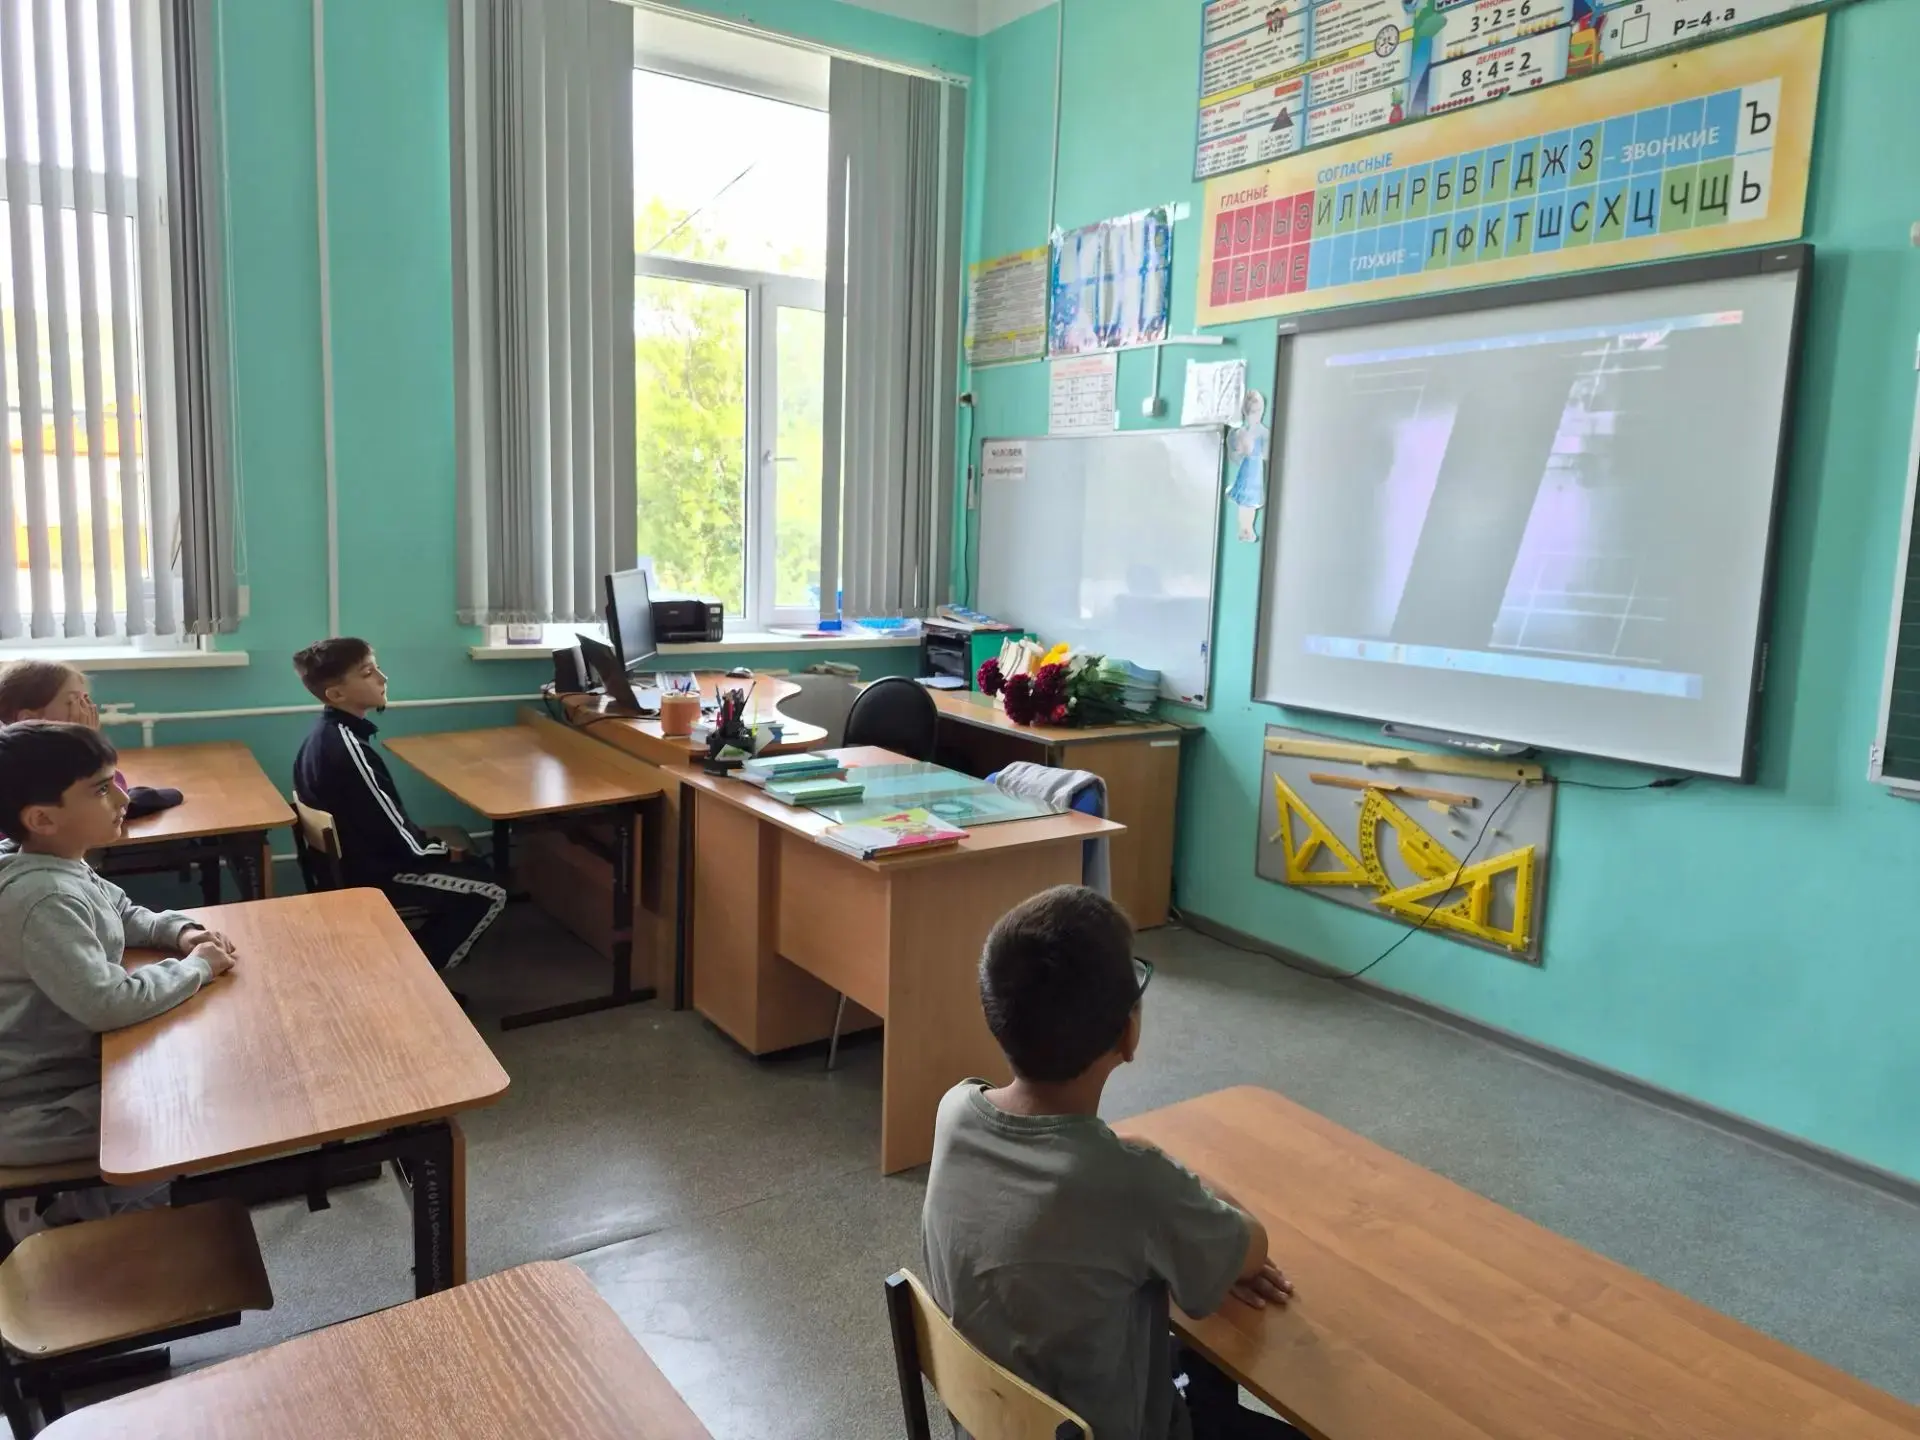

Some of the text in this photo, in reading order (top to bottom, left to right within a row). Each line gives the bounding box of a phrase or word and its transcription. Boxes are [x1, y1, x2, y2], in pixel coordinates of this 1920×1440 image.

[1471, 16, 1480, 32] 3
[1492, 9, 1502, 26] 2
[1520, 0, 1530, 16] 6
[1461, 69, 1472, 87] 8
[1487, 61, 1499, 78] 4
[1519, 52, 1531, 71] 2
[1746, 100, 1771, 135] Ъ
[1620, 126, 1721, 163] ЗВОНКИЕ
[1317, 152, 1393, 184] СОГЛАСНЫЕ
[1220, 184, 1269, 209] ГЛАСНЫЕ
[1740, 170, 1761, 204] Ь
[1351, 249, 1406, 270] ГЛУХИЕ
